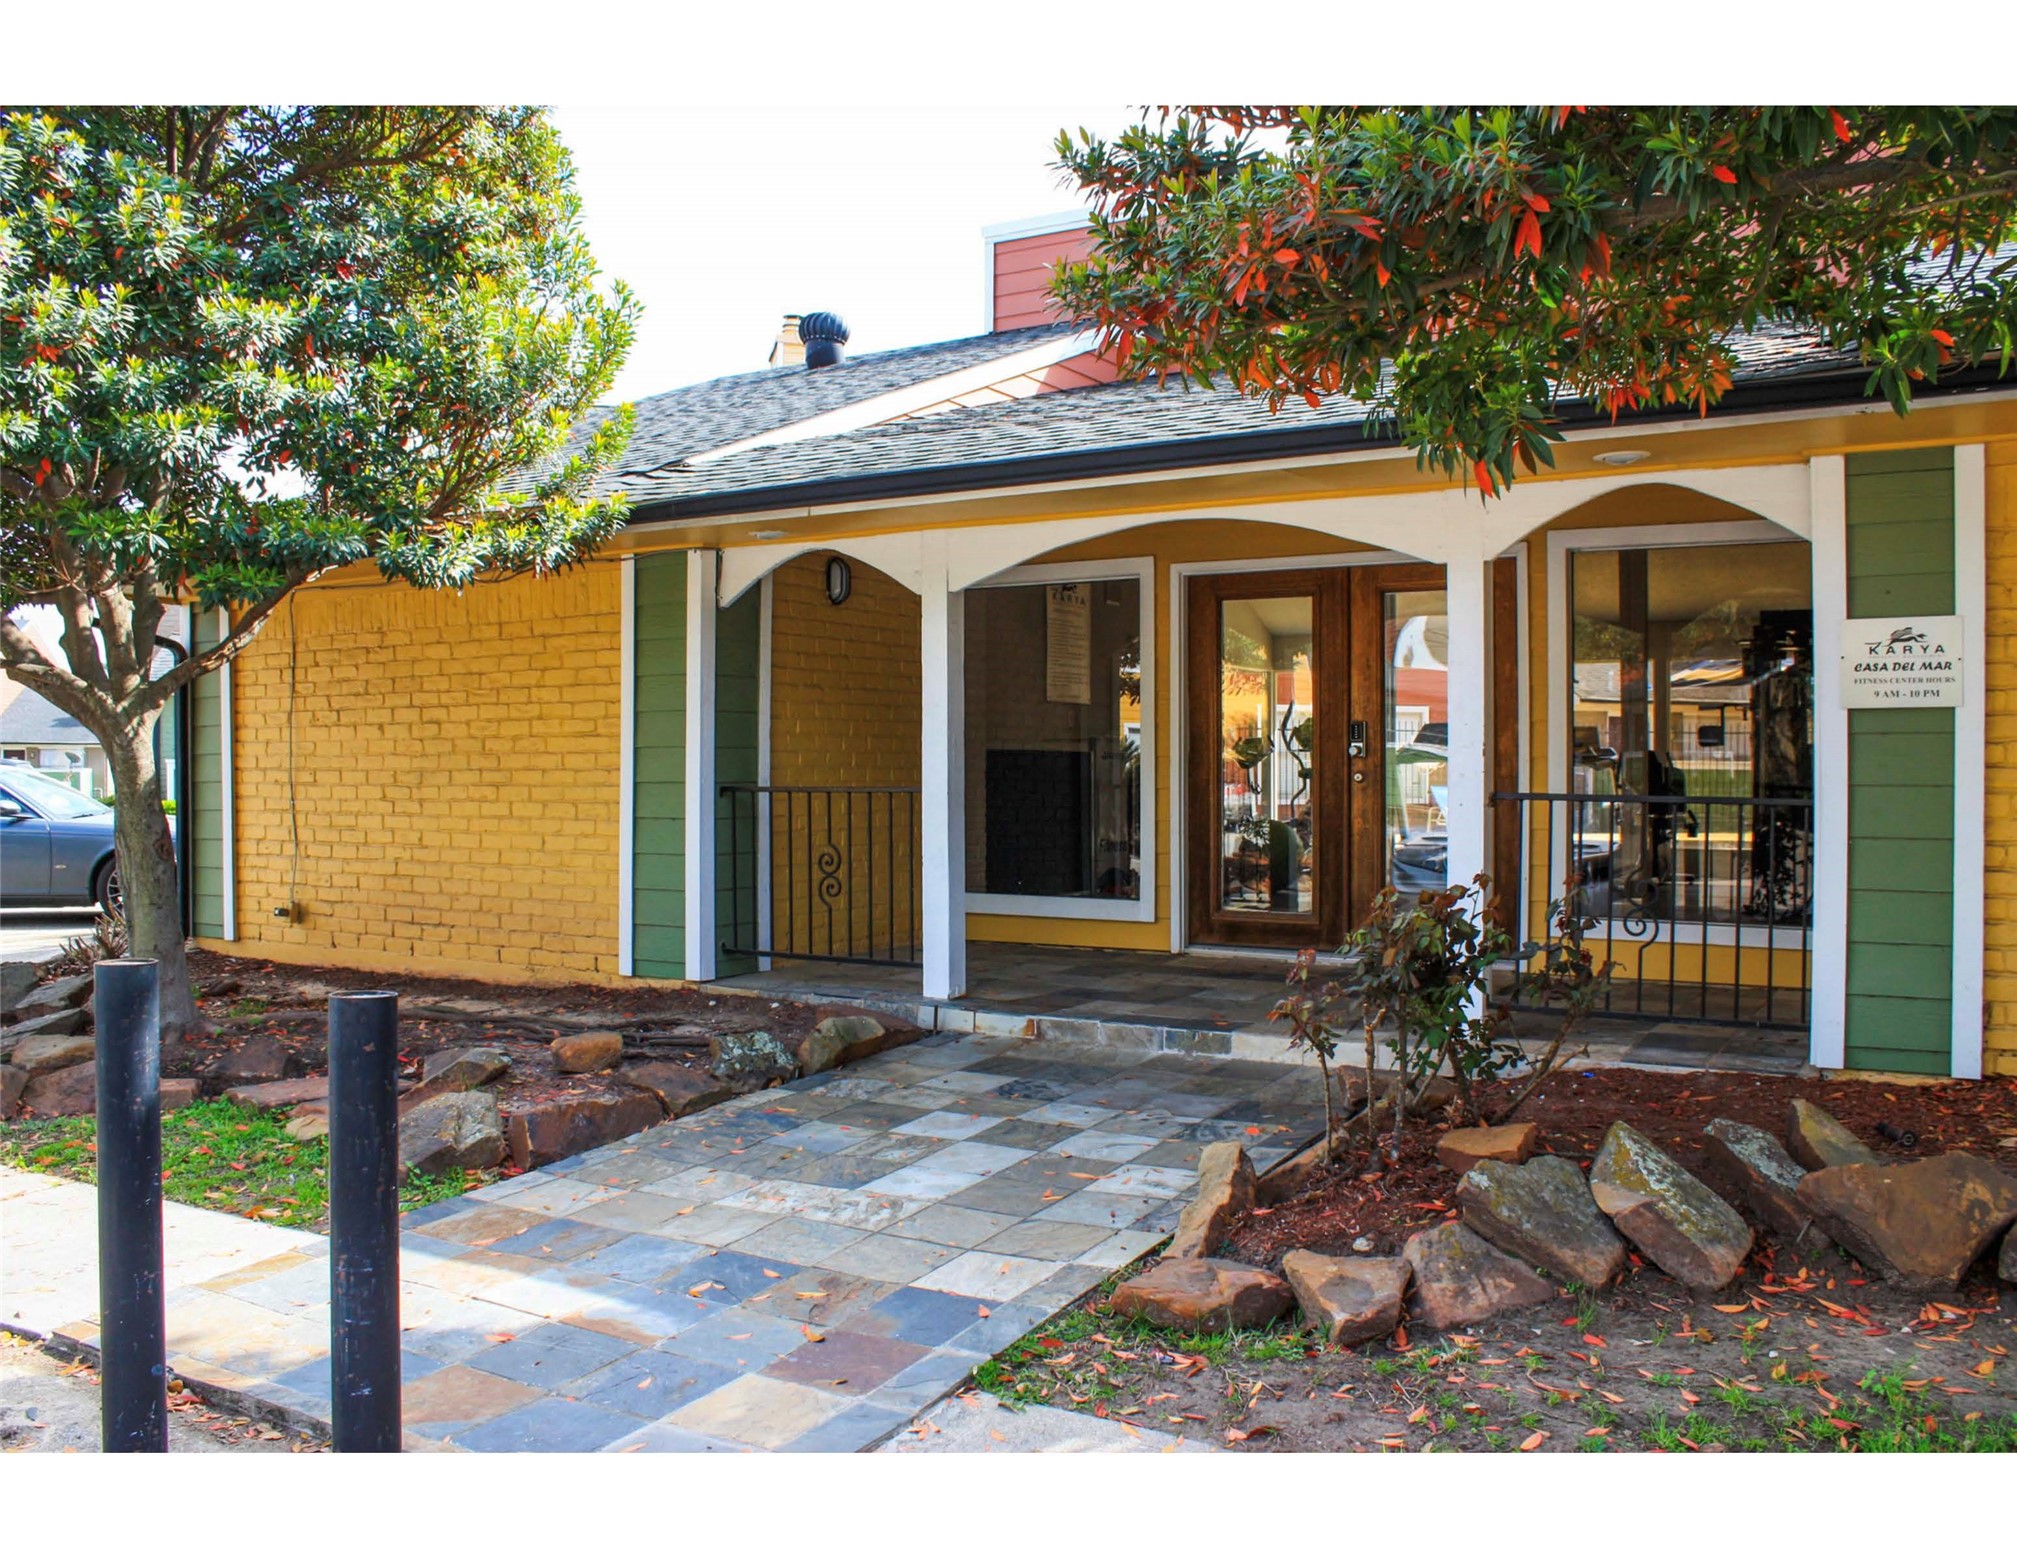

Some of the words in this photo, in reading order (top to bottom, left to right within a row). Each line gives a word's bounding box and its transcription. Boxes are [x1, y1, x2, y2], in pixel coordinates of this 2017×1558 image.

[1868, 643, 1945, 655] KARYA
[1854, 662, 1889, 672] CASA
[1892, 661, 1915, 671] DEL
[1919, 661, 1953, 671] MAR
[1854, 677, 1888, 685] FITNESS
[1889, 677, 1925, 685] CENTER
[1926, 676, 1956, 684] HOURS
[1874, 690, 1880, 699] 9
[1882, 690, 1900, 699] AM
[1909, 690, 1920, 699] 10
[1923, 690, 1941, 698] PM
